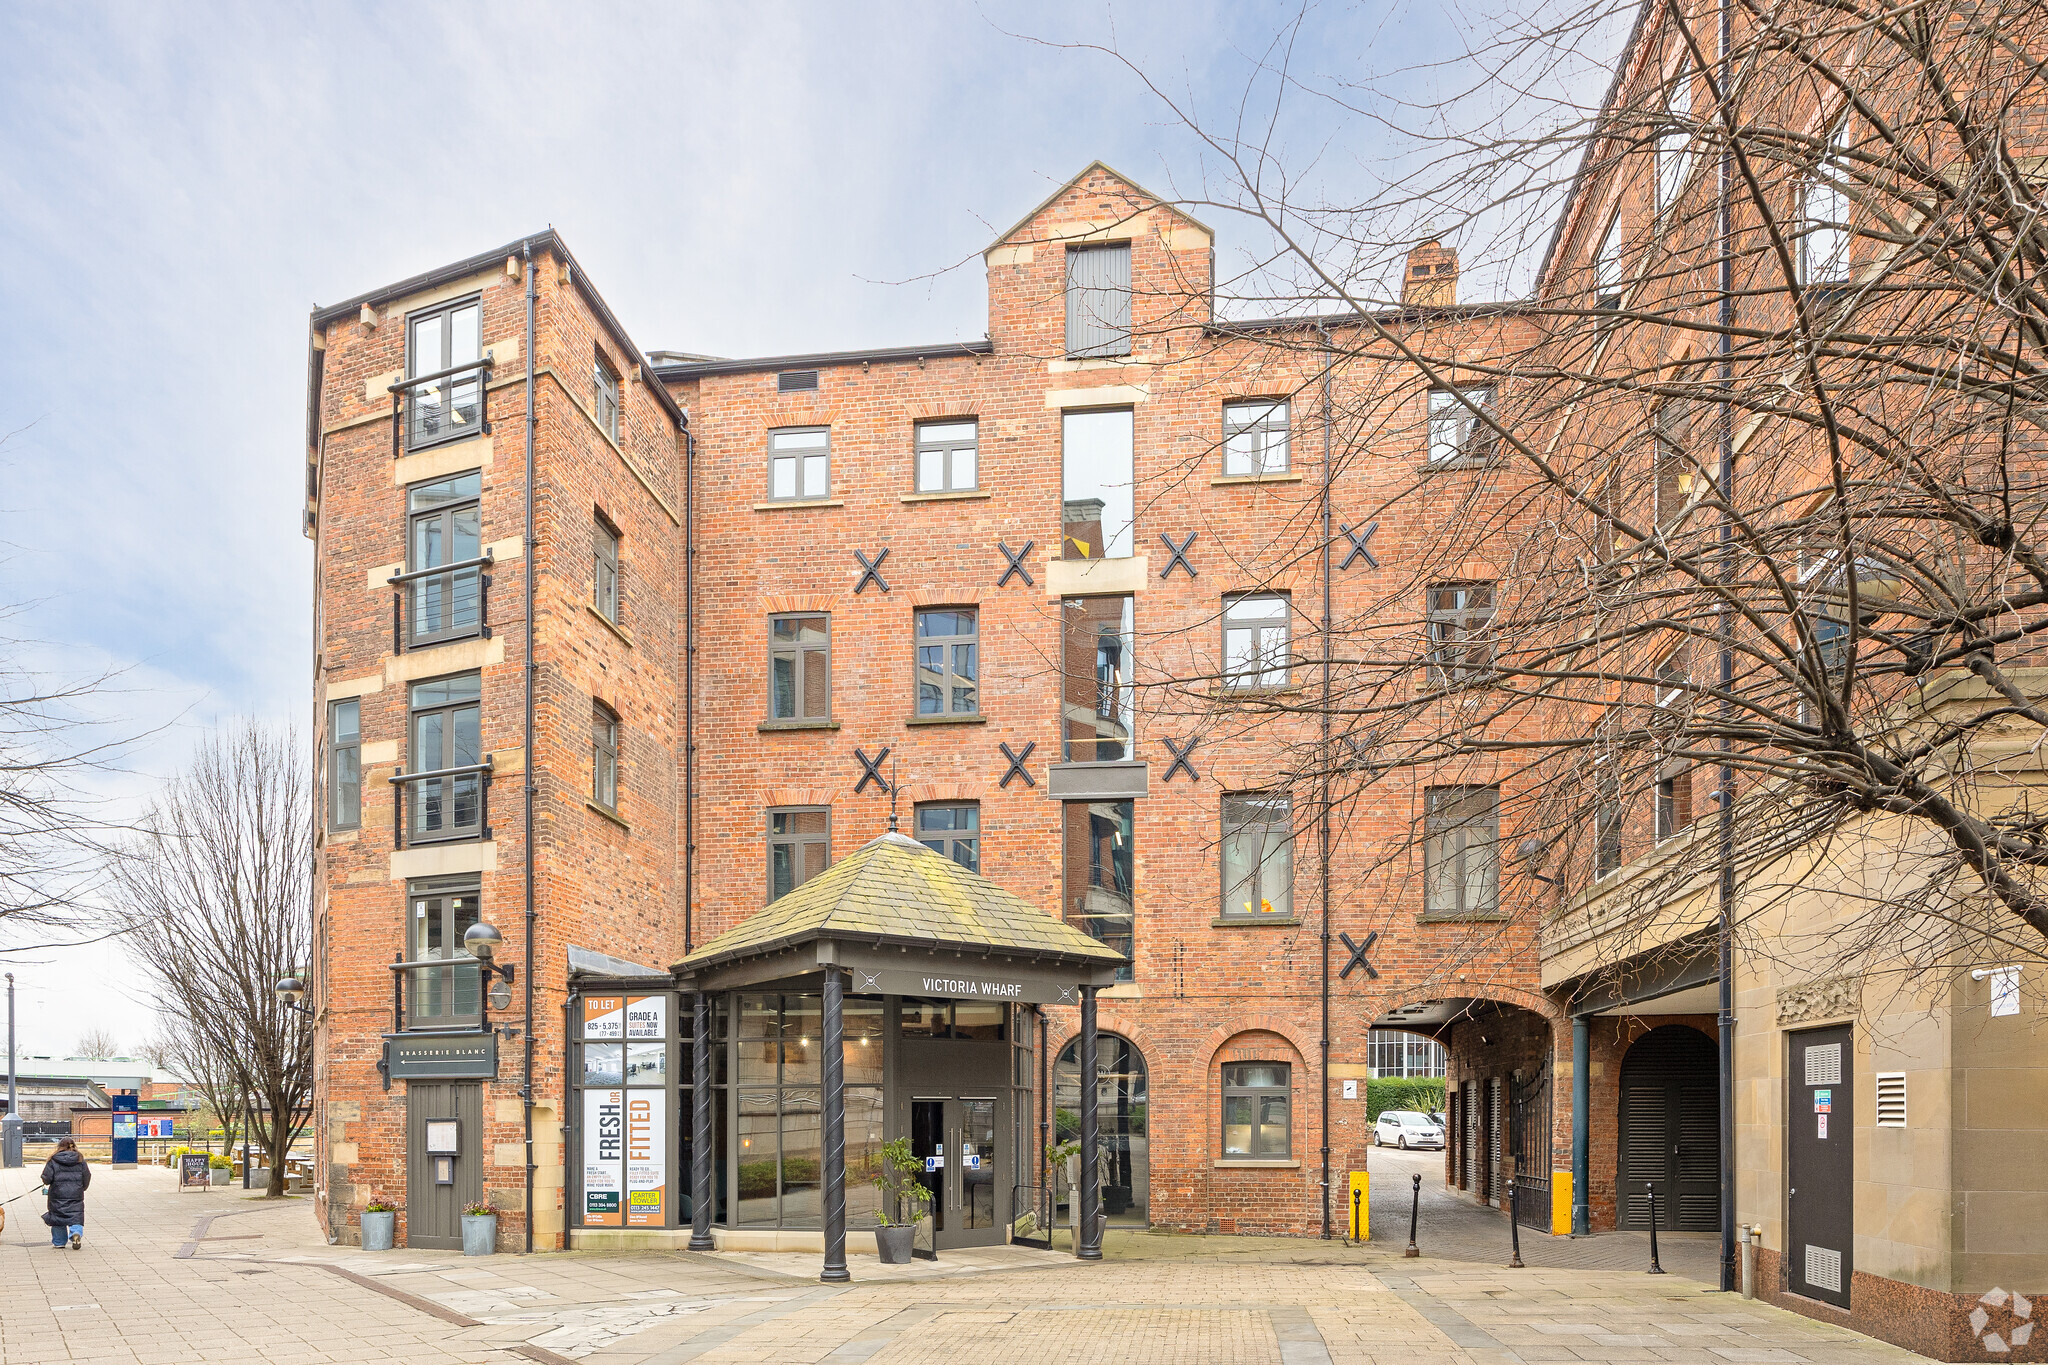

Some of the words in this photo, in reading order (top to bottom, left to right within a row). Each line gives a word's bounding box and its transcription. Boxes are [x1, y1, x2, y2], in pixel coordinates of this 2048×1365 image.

[922, 978, 978, 994] VICTORIA
[981, 982, 1022, 997] WHARF
[588, 1000, 598, 1009] TO
[601, 1000, 615, 1009] LET
[629, 1012, 651, 1021] GRADE
[652, 1012, 658, 1021] A
[587, 1022, 598, 1030] 825
[629, 1021, 646, 1029] SUITES
[646, 1021, 658, 1029] NOW
[400, 1049, 450, 1057] BRASSERIE
[609, 1091, 620, 1103] OR
[599, 1104, 620, 1160] FRESH
[629, 1100, 650, 1160] FITTED
